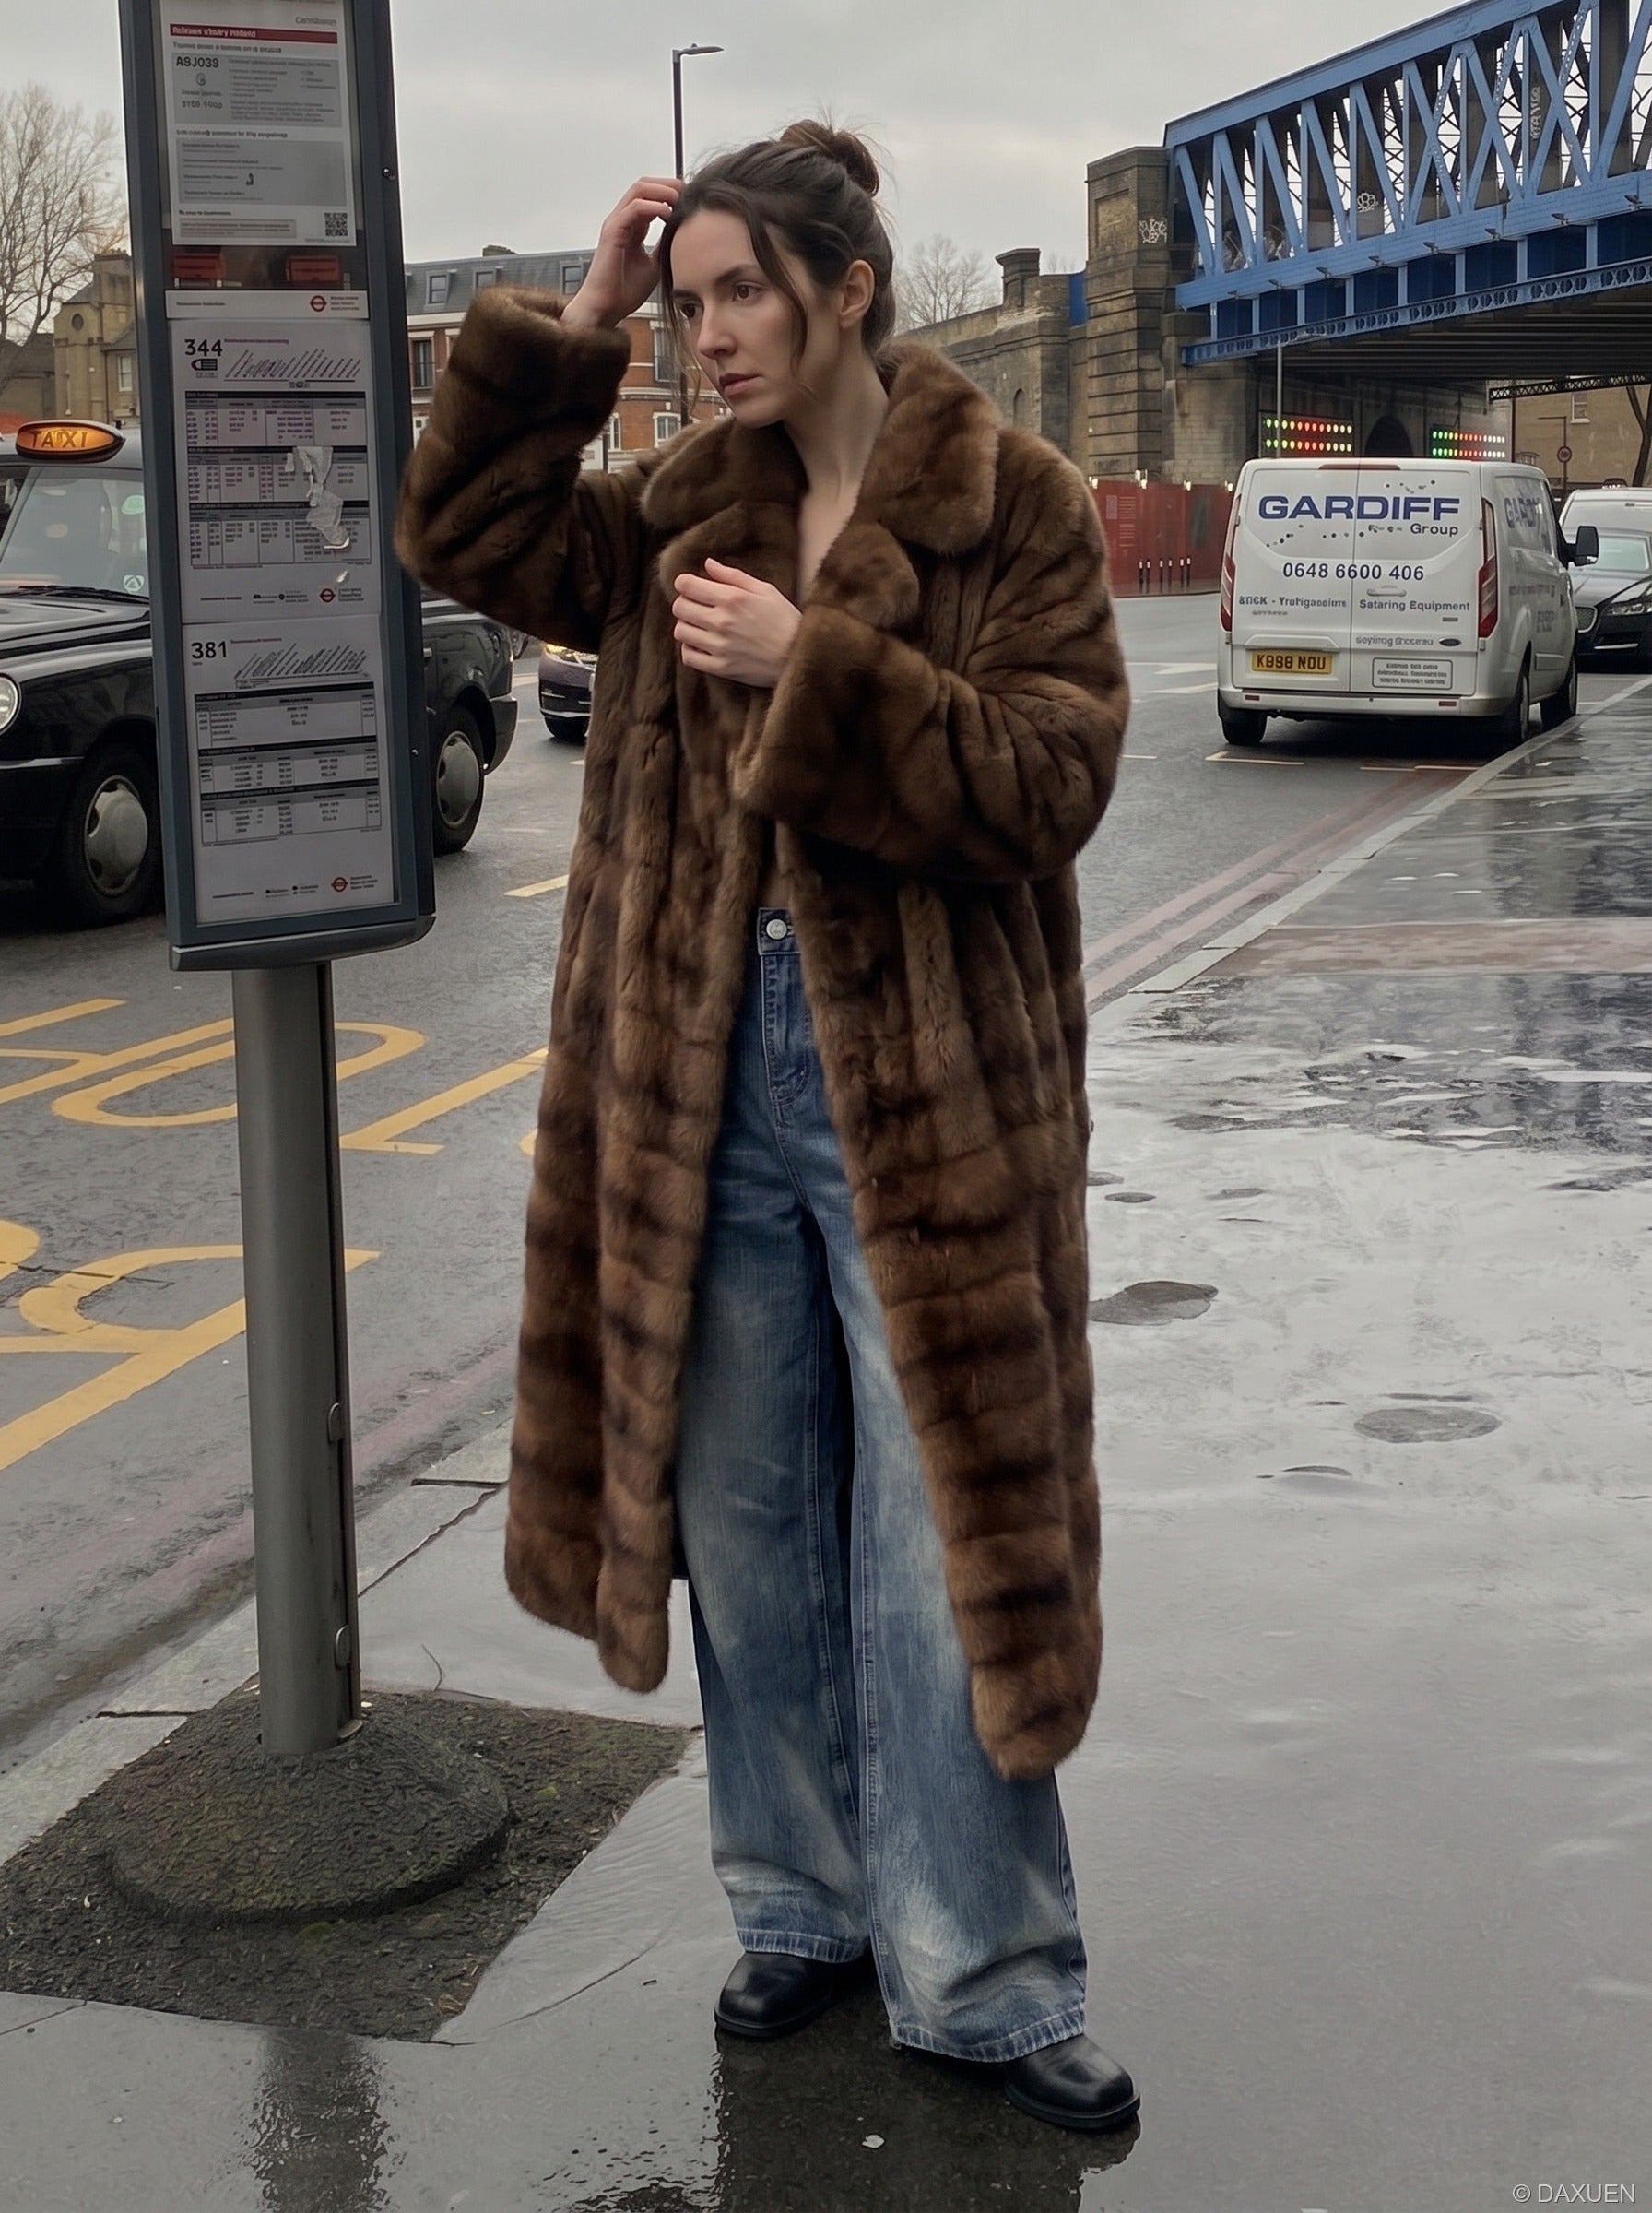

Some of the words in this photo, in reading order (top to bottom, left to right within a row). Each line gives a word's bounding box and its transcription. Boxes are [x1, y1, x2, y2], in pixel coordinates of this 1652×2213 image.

[184, 338, 223, 357] 344
[30, 430, 88, 449] TAXI
[1258, 495, 1460, 521] GARDIFF
[1410, 523, 1459, 538] Group
[1282, 562, 1329, 579] 0648
[1335, 563, 1382, 580] 6600
[1388, 564, 1424, 581] 406
[1409, 599, 1470, 613] Equipment
[191, 641, 227, 659] 381
